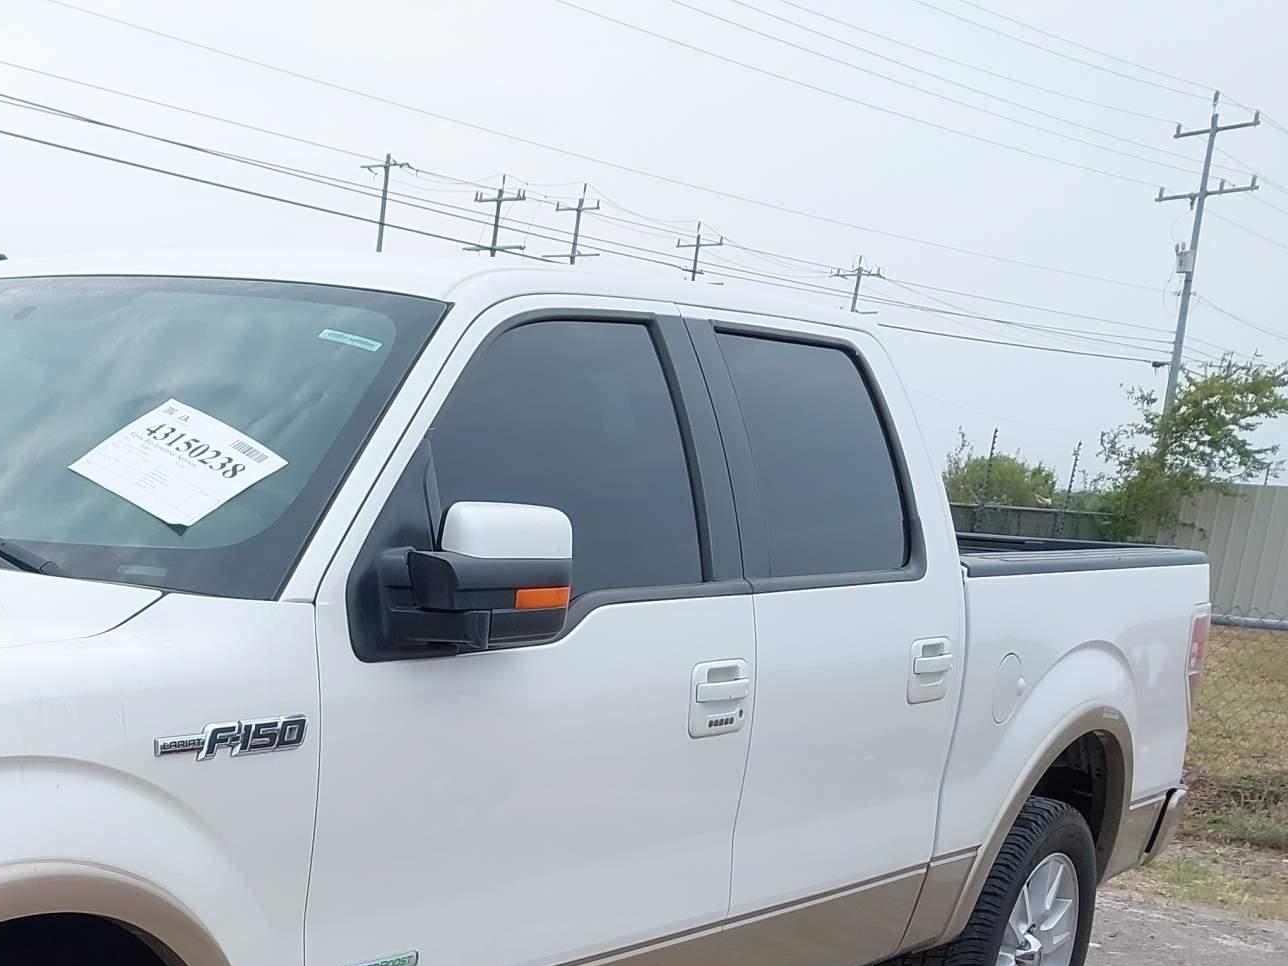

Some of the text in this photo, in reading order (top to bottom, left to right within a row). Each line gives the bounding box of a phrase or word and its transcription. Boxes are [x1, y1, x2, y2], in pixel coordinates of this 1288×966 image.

[146, 423, 246, 479] 43150238
[163, 738, 202, 751] LARIAT
[198, 716, 307, 760] F-150
